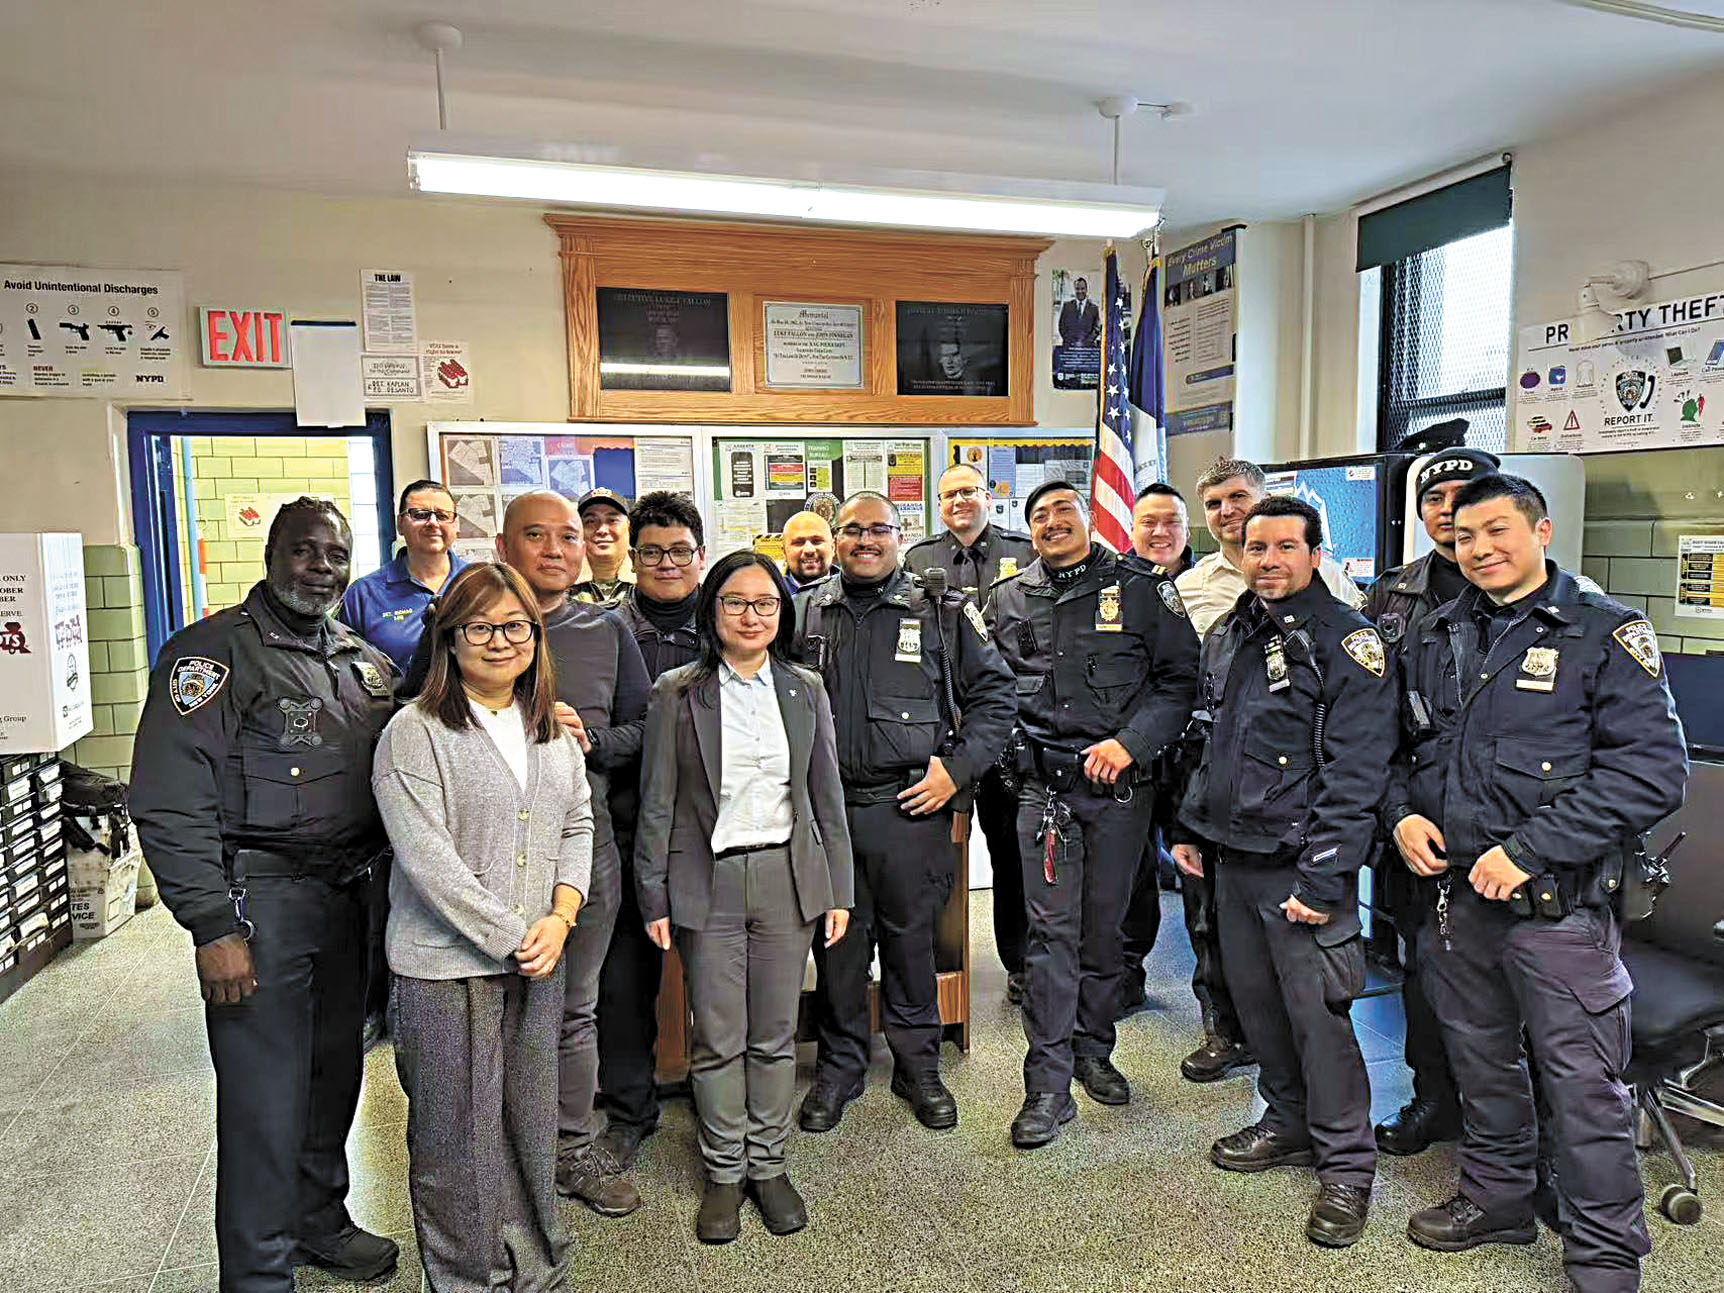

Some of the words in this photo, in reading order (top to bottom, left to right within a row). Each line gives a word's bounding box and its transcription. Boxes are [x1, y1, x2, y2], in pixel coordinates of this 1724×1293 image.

[374, 274, 386, 282] THE
[387, 274, 401, 282] LAW
[4, 280, 32, 290] Avoid
[34, 281, 101, 292] Unintentional
[104, 284, 158, 296] Discharges
[1658, 294, 1724, 324] THEF
[208, 310, 282, 362] EXIT
[1604, 414, 1641, 426] REPORT
[1420, 460, 1473, 484] NYPD
[1058, 564, 1086, 578] NYPD
[178, 665, 220, 680] DEPARTMENT
[189, 661, 214, 670] POLICE
[72, 912, 96, 920] VICE
